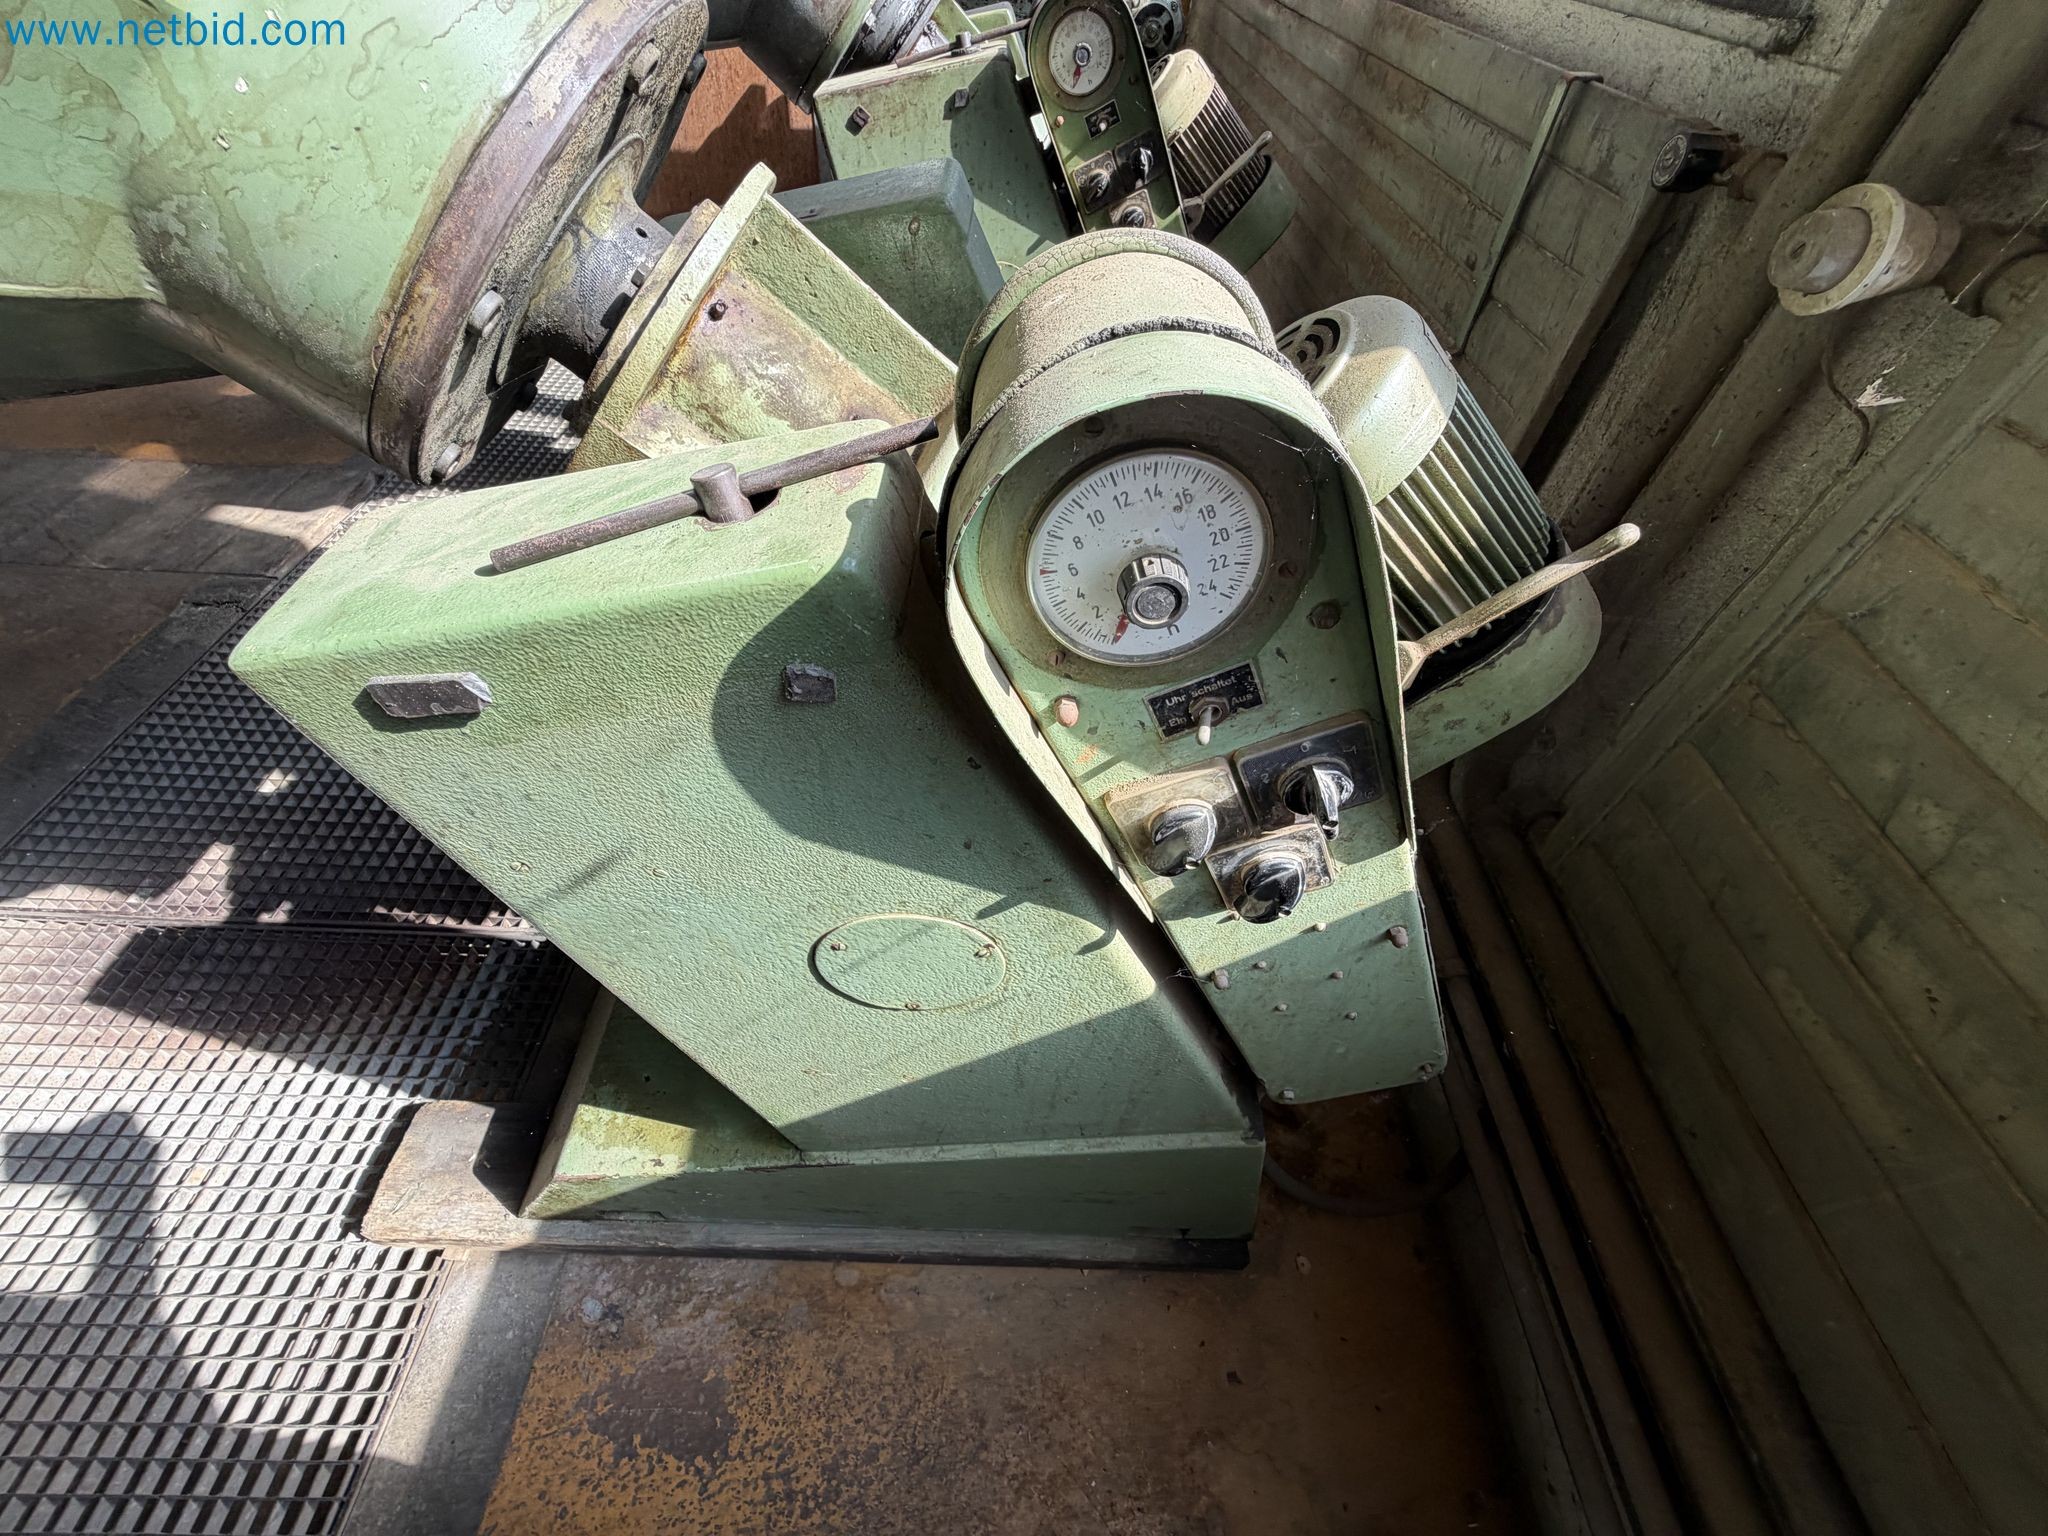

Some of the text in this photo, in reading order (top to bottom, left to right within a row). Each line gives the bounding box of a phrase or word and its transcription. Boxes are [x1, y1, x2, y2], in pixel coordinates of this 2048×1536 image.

[1112, 491, 1131, 511] 12
[1144, 483, 1164, 503] 14
[1175, 488, 1194, 507] 16
[1086, 509, 1105, 528] 10
[1198, 504, 1217, 523] 18
[1072, 535, 1084, 550] 8
[1209, 527, 1230, 547] 20
[1067, 563, 1079, 577] 6
[1207, 554, 1230, 573] 22
[1076, 587, 1086, 601] 4
[1197, 579, 1217, 597] 24
[1092, 605, 1104, 620] 2
[1165, 675, 1237, 707] Uhr schaltet
[1168, 694, 1254, 728] Ein Aus
